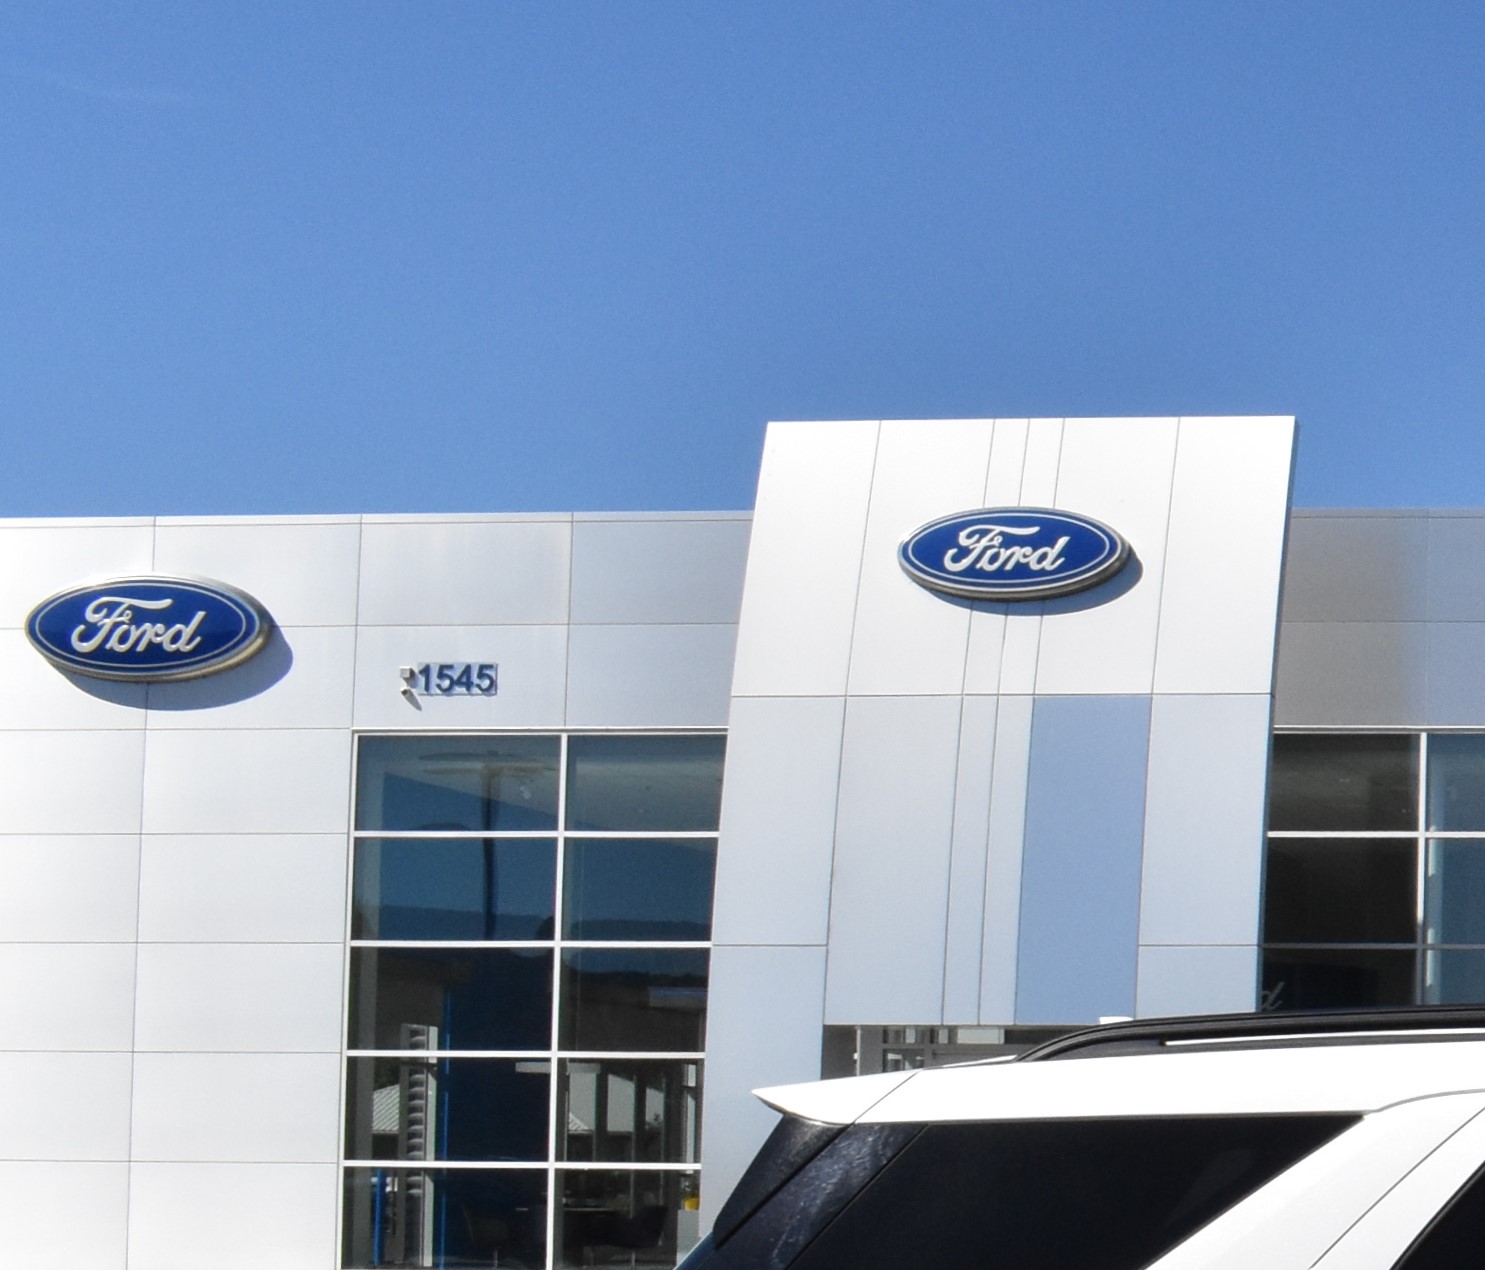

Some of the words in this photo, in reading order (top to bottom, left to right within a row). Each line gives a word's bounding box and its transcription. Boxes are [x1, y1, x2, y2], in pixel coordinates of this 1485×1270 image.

[944, 525, 1066, 572] Ford
[71, 596, 207, 654] Ford
[418, 664, 495, 693] 1545
